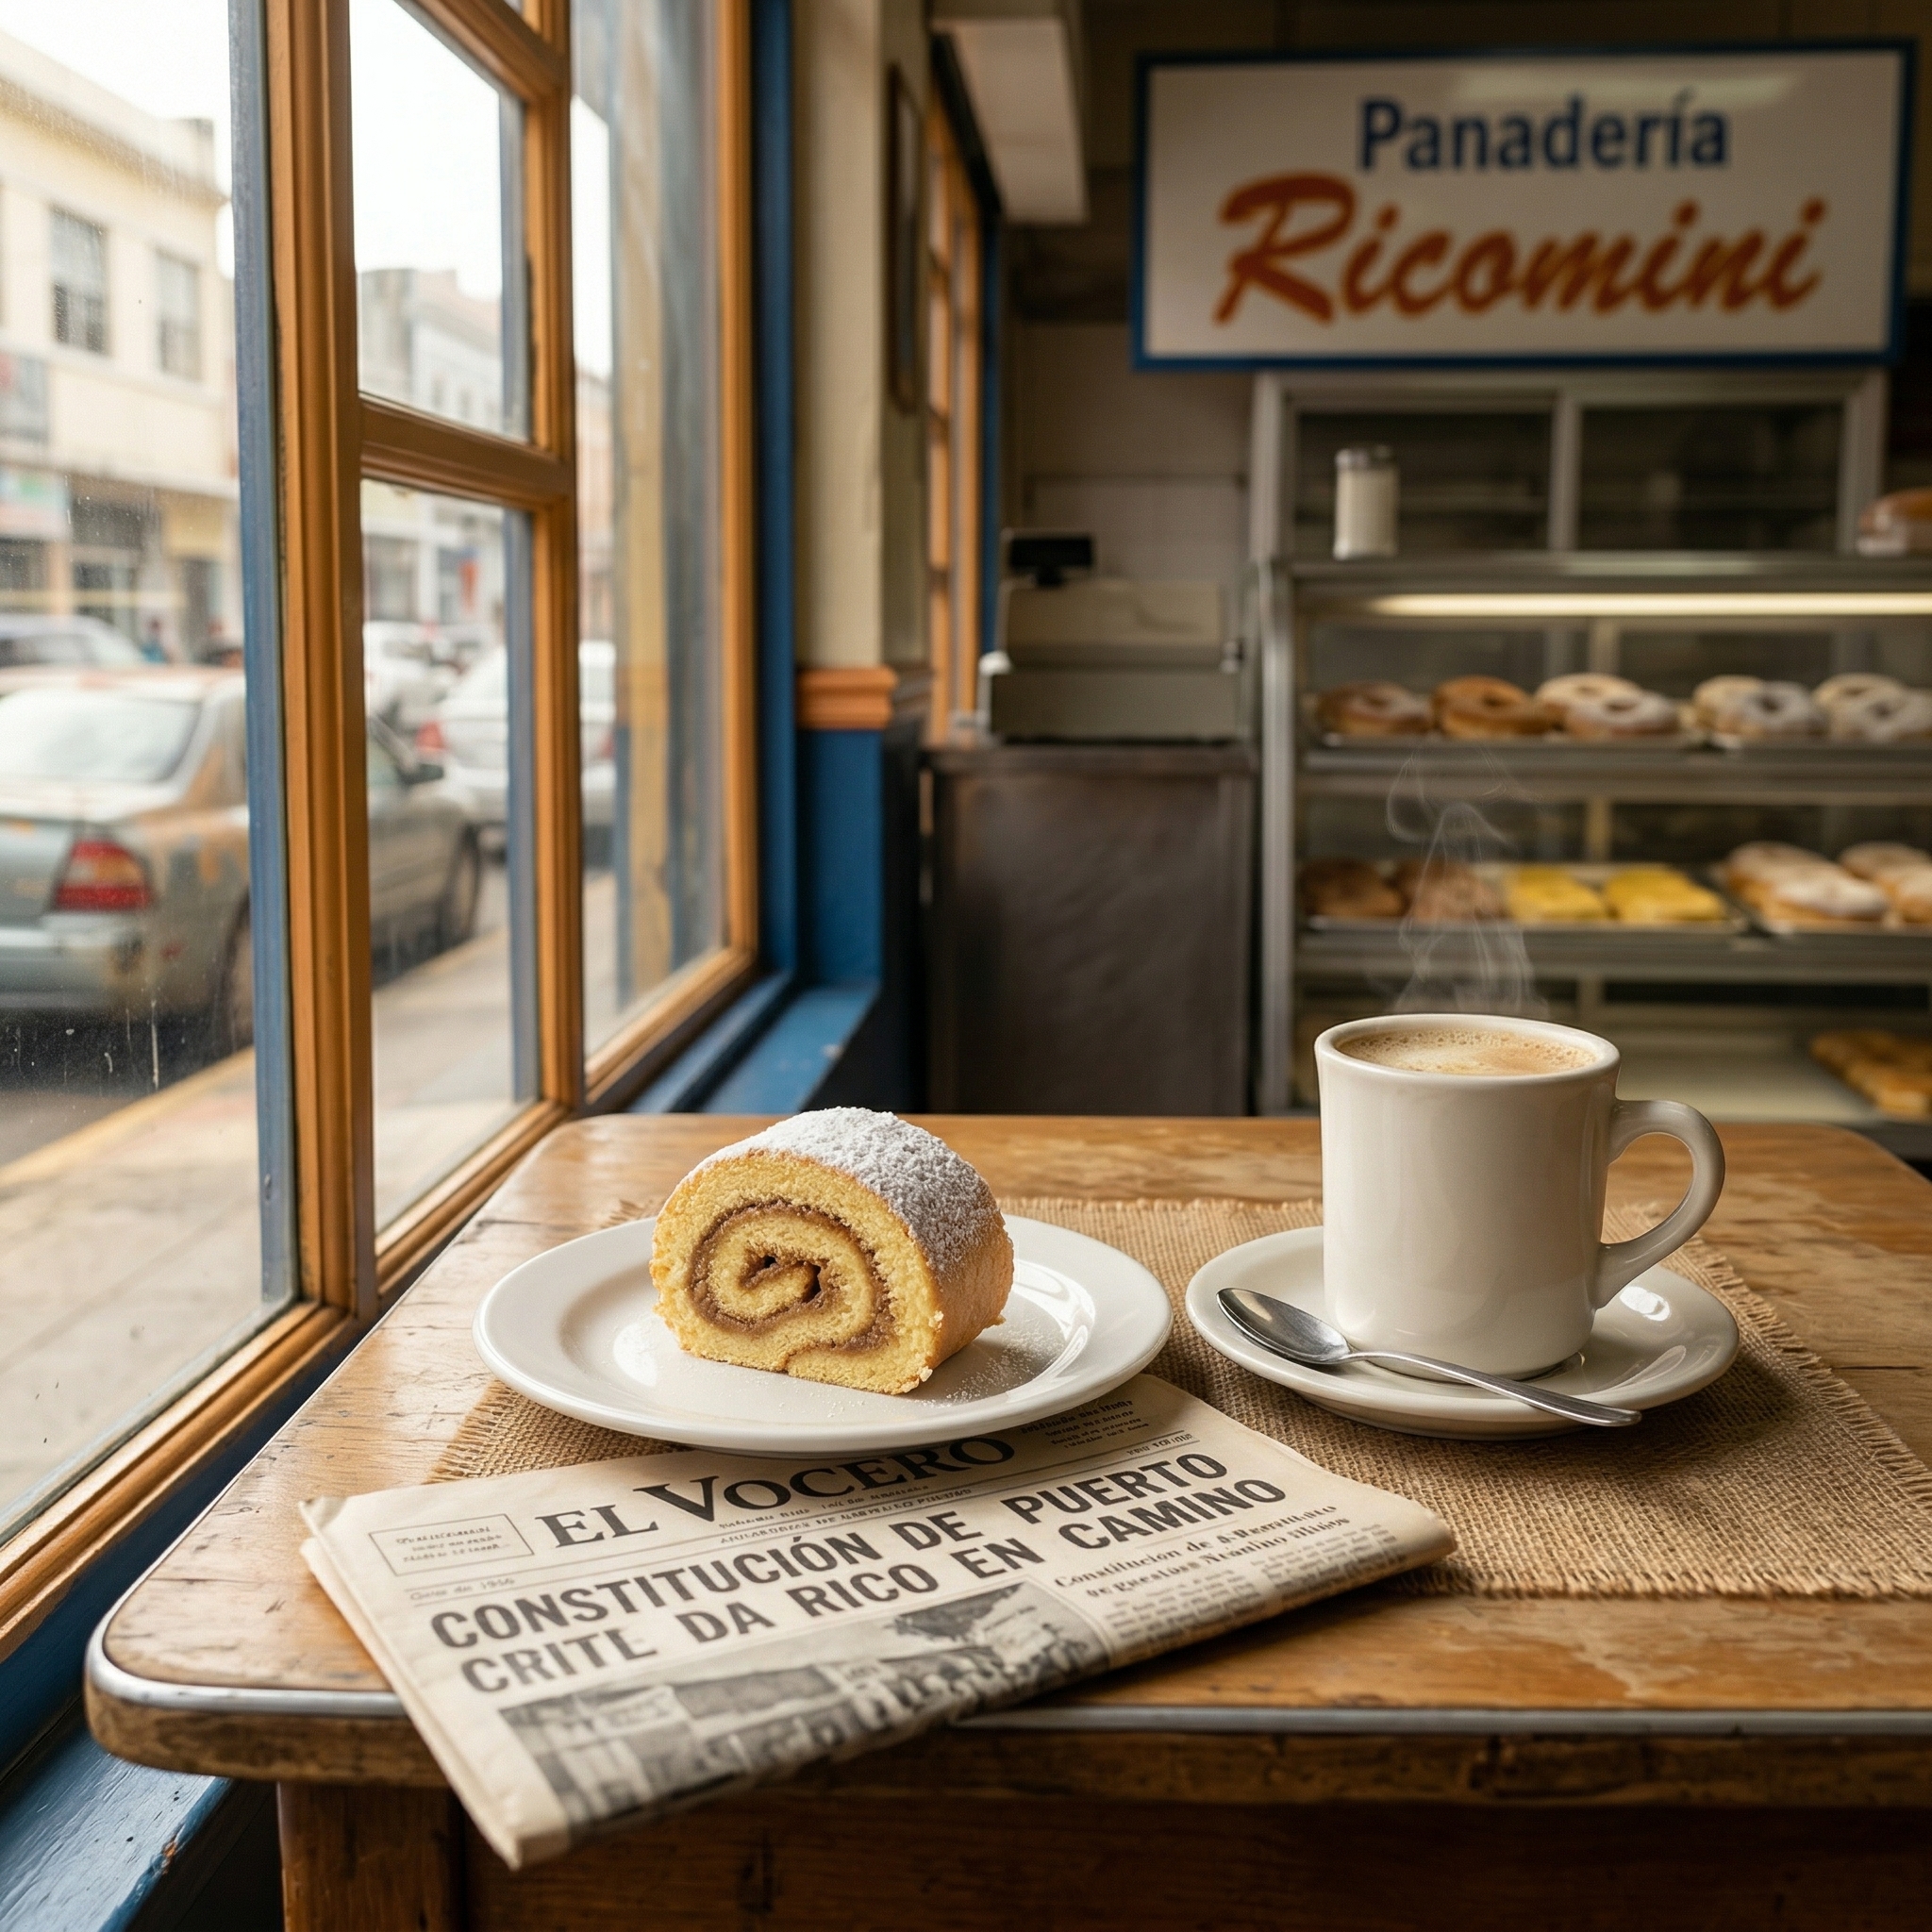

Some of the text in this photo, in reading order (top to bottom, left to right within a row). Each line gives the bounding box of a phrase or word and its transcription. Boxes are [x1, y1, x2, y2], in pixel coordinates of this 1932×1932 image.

[1359, 91, 1729, 170] Panadería
[1213, 174, 1826, 325] Ricomini
[429, 1532, 883, 1650] CONSTITUCIÓN
[889, 1511, 984, 1551] DE
[1000, 1453, 1227, 1524] PUERTO
[535, 1505, 658, 1548] EL
[633, 1436, 1015, 1522] VOCERO
[676, 1602, 775, 1643] DA
[785, 1563, 939, 1617] RICO
[951, 1538, 1046, 1579] EN
[1058, 1479, 1286, 1550] CAMINO
